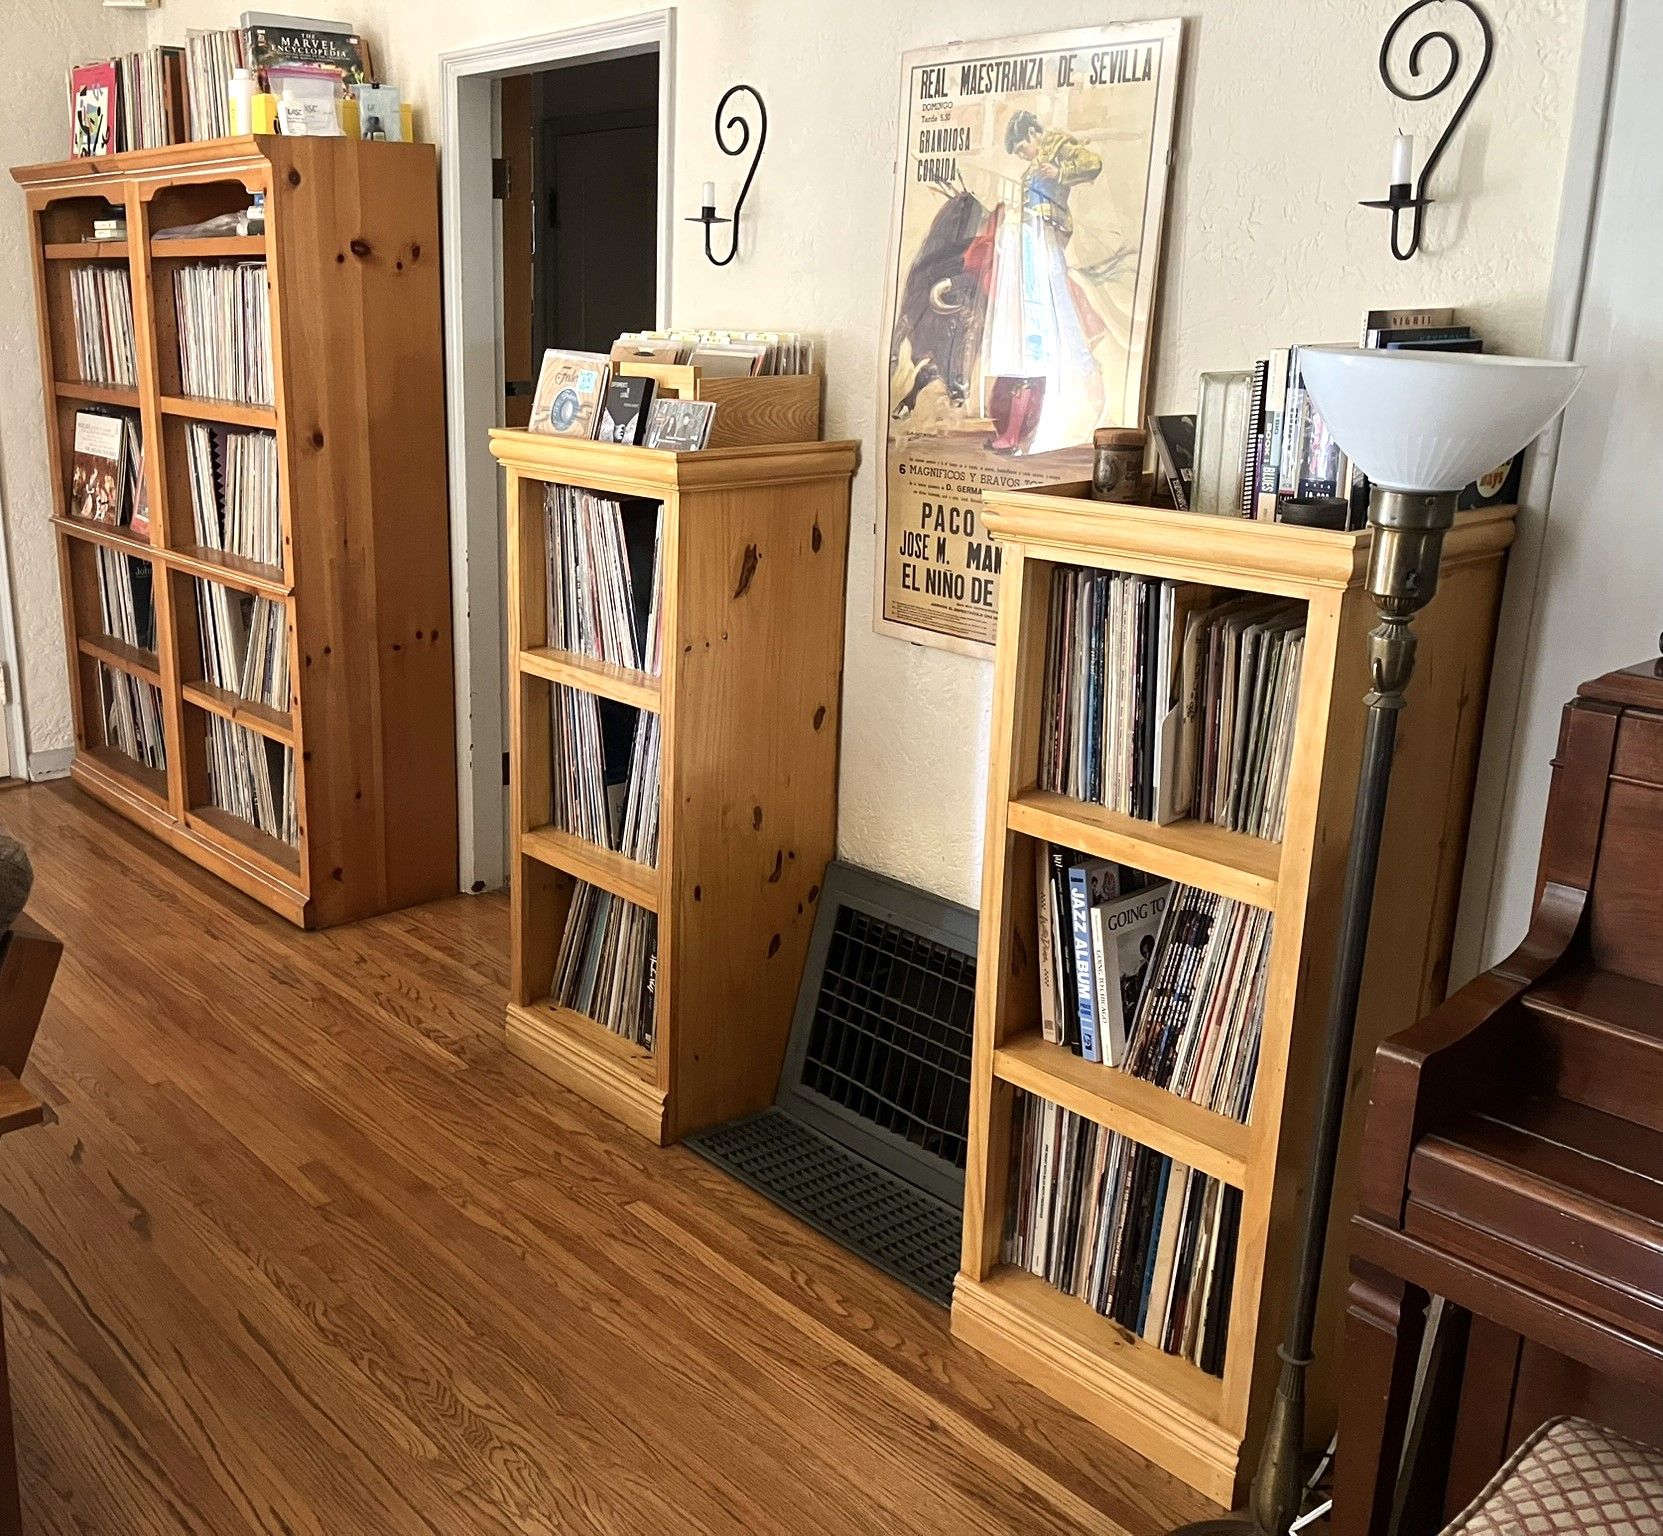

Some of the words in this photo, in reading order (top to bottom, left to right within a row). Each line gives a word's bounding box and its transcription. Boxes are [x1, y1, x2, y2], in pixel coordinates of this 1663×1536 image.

[271, 44, 347, 57] ENCYCLOPEDIA
[281, 36, 336, 50] MARVEL
[920, 69, 949, 99] REAL
[960, 57, 1044, 97] MAESTRANZA
[1057, 53, 1076, 87] DE
[1090, 47, 1152, 86] SEVILLA
[922, 101, 954, 112] DOMINGO
[919, 126, 971, 154] GRANDIOSA
[917, 157, 956, 182] CORRIDA
[1265, 422, 1273, 455] BOOK
[899, 463, 906, 475] 6
[909, 464, 966, 481] MAGNIFICOS
[969, 473, 977, 483] Y
[980, 474, 1020, 488] BRAVOS
[1261, 466, 1275, 493] BLUES
[921, 502, 975, 537] PACO
[900, 530, 930, 561] JOSE
[936, 537, 950, 565] M.
[902, 563, 921, 592] EL
[926, 567, 965, 600] NIÑO
[970, 576, 994, 607] DE
[1071, 887, 1087, 934] JAZZ
[1108, 904, 1148, 931] GOING
[1149, 896, 1166, 915] TO
[1074, 935, 1091, 1000] ALBUM
[1095, 950, 1103, 976] GOING
[1100, 987, 1108, 1025] CHICAGO
